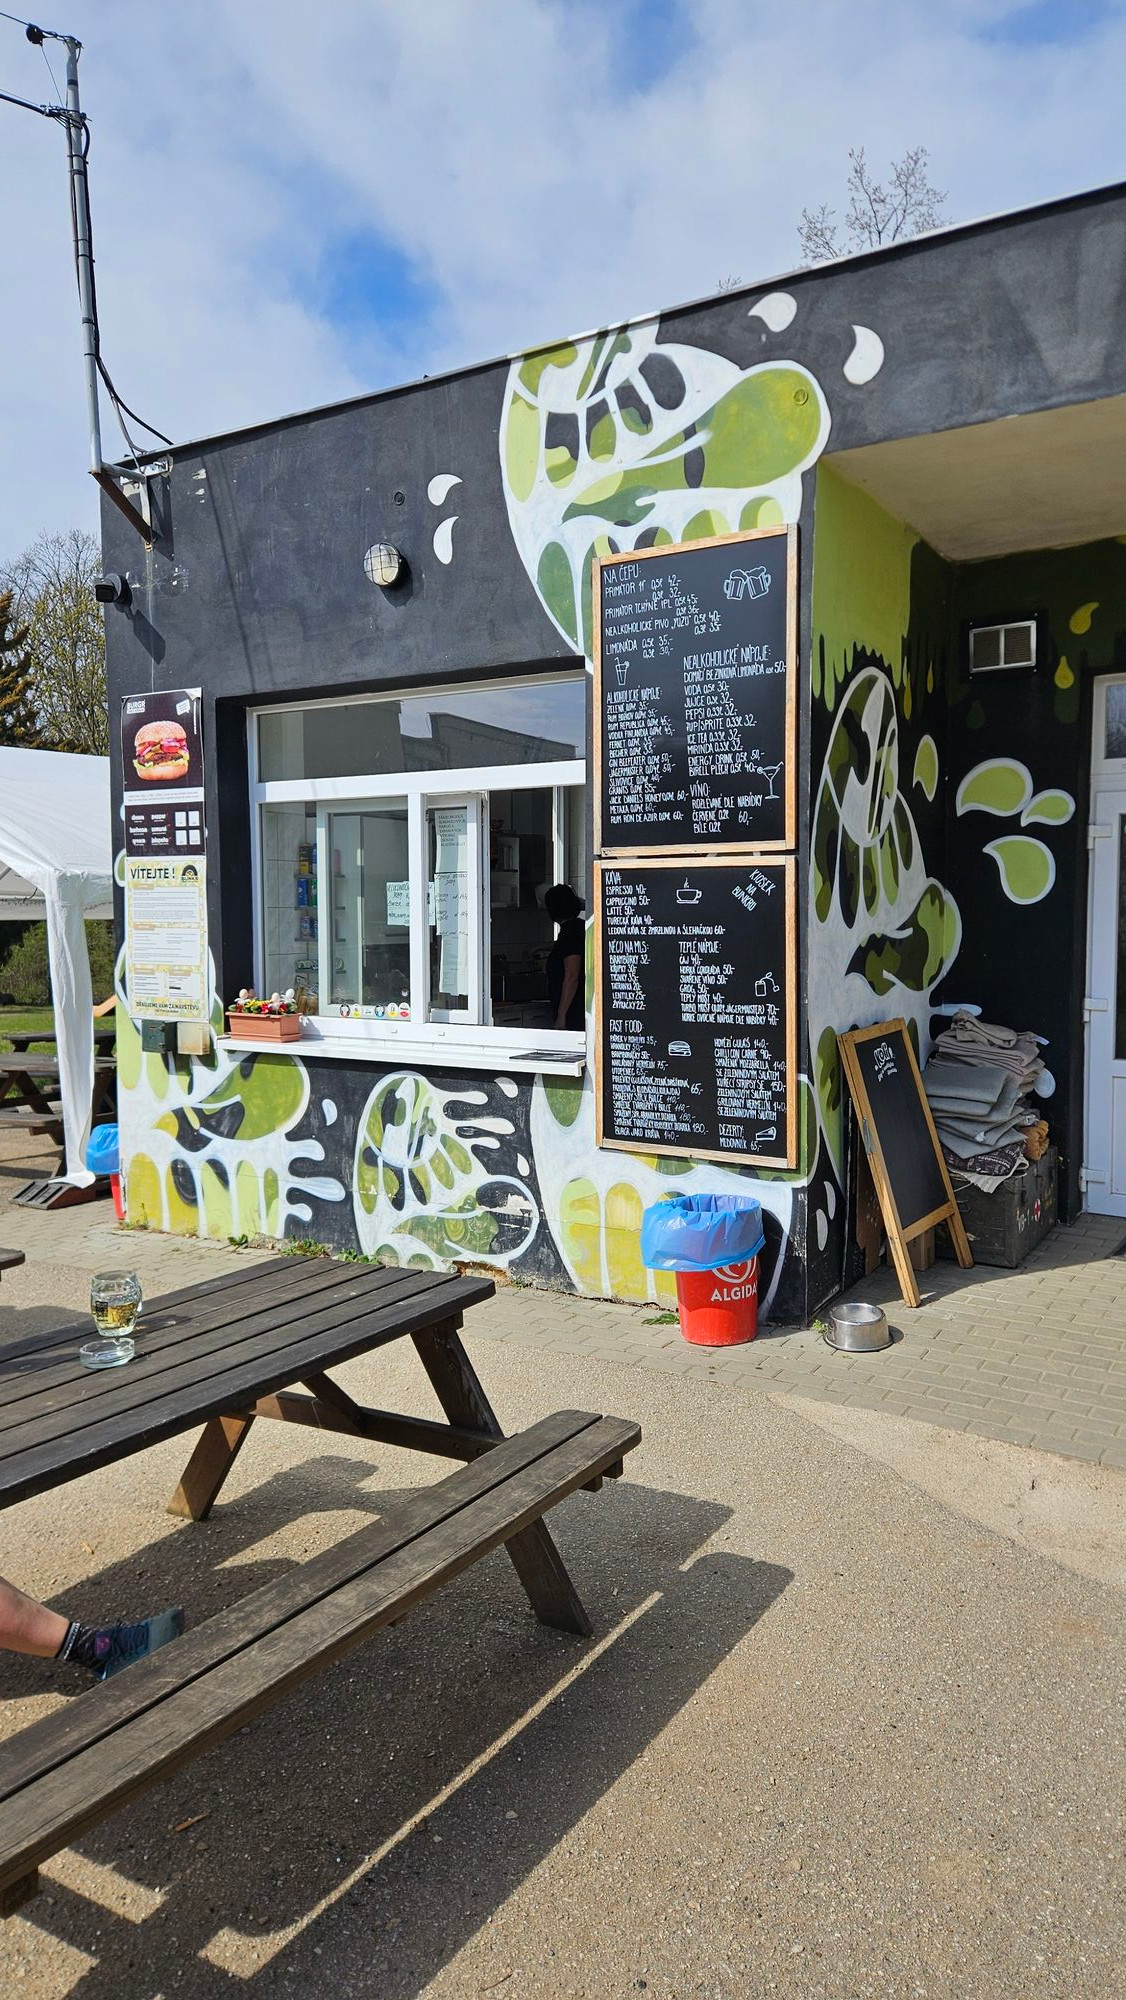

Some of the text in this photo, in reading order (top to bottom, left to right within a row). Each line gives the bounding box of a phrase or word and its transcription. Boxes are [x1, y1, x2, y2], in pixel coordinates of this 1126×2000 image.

[604, 564, 641, 584] NA ČEPU:
[605, 617, 653, 636] NEALKOHOLICKÉ
[655, 618, 669, 629] PIVO
[606, 639, 637, 655] LIMONÁDA
[684, 644, 739, 671] NEALKOHOLICKÉ
[684, 684, 702, 695] VODA
[703, 684, 715, 694] 0,5l
[686, 708, 705, 720] PEPSI
[698, 732, 708, 744] TEA
[687, 743, 714, 754] MIRINDA
[688, 755, 713, 767] ENERGY
[716, 753, 733, 765] DRINK
[711, 764, 728, 775] PLECH
[690, 780, 710, 797] VÍNO:
[724, 797, 735, 808] DLE
[130, 866, 176, 880] VÍTEJTE !
[749, 869, 776, 896] KIOSEK
[606, 886, 633, 895] ESPRESSO
[746, 884, 757, 896] NA
[606, 896, 637, 906] CAPPUCCINO
[732, 885, 757, 911] BUNKRU
[677, 927, 681, 935] A
[625, 941, 633, 954] NA
[610, 1019, 623, 1032] FAST
[711, 1284, 757, 1303] ALGIDA
